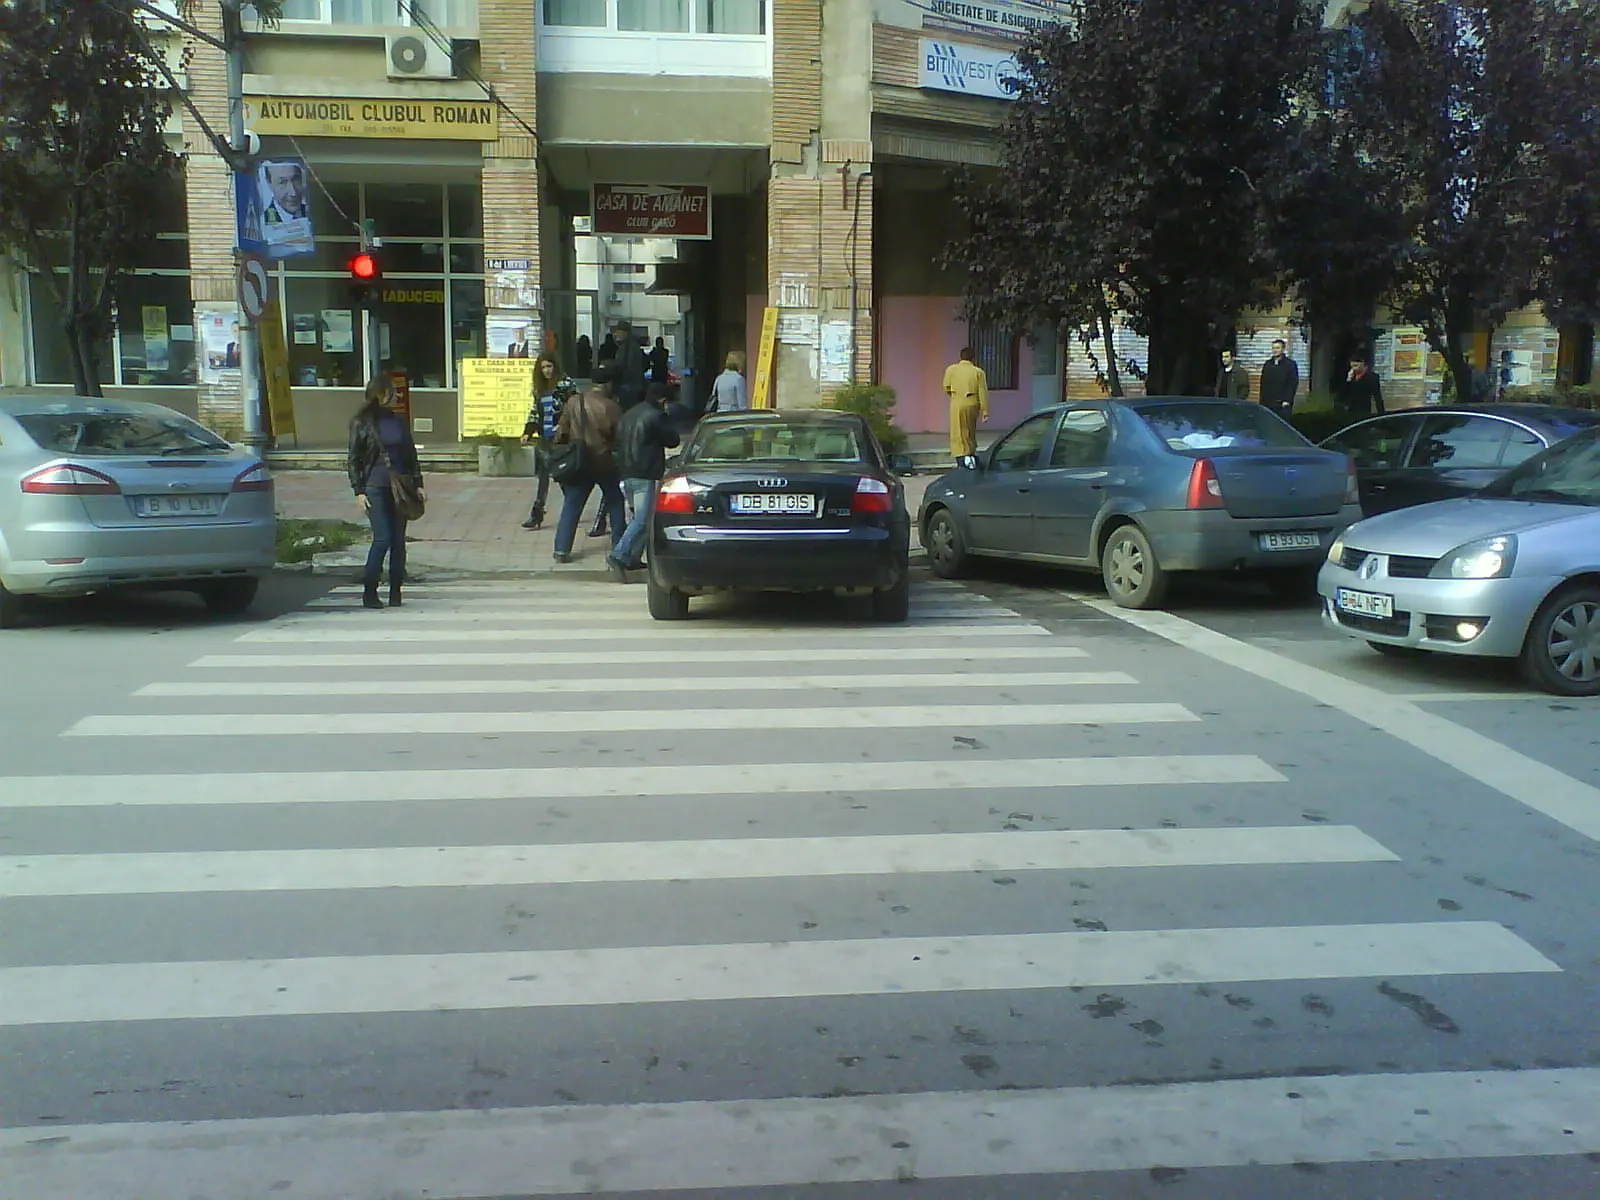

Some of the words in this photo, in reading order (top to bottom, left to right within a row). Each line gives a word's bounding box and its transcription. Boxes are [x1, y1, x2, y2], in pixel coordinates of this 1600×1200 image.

[931, 0, 983, 20] SOCIETATE
[986, 10, 998, 23] DE
[927, 55, 993, 80] BITINVEST
[260, 101, 354, 121] AUTOMOBIL
[362, 104, 426, 123] CLUBUL
[433, 106, 491, 125] ROMAN
[597, 194, 627, 211] CASA
[632, 194, 648, 211] DE
[653, 193, 706, 213] AMANET
[1270, 534, 1277, 546] B
